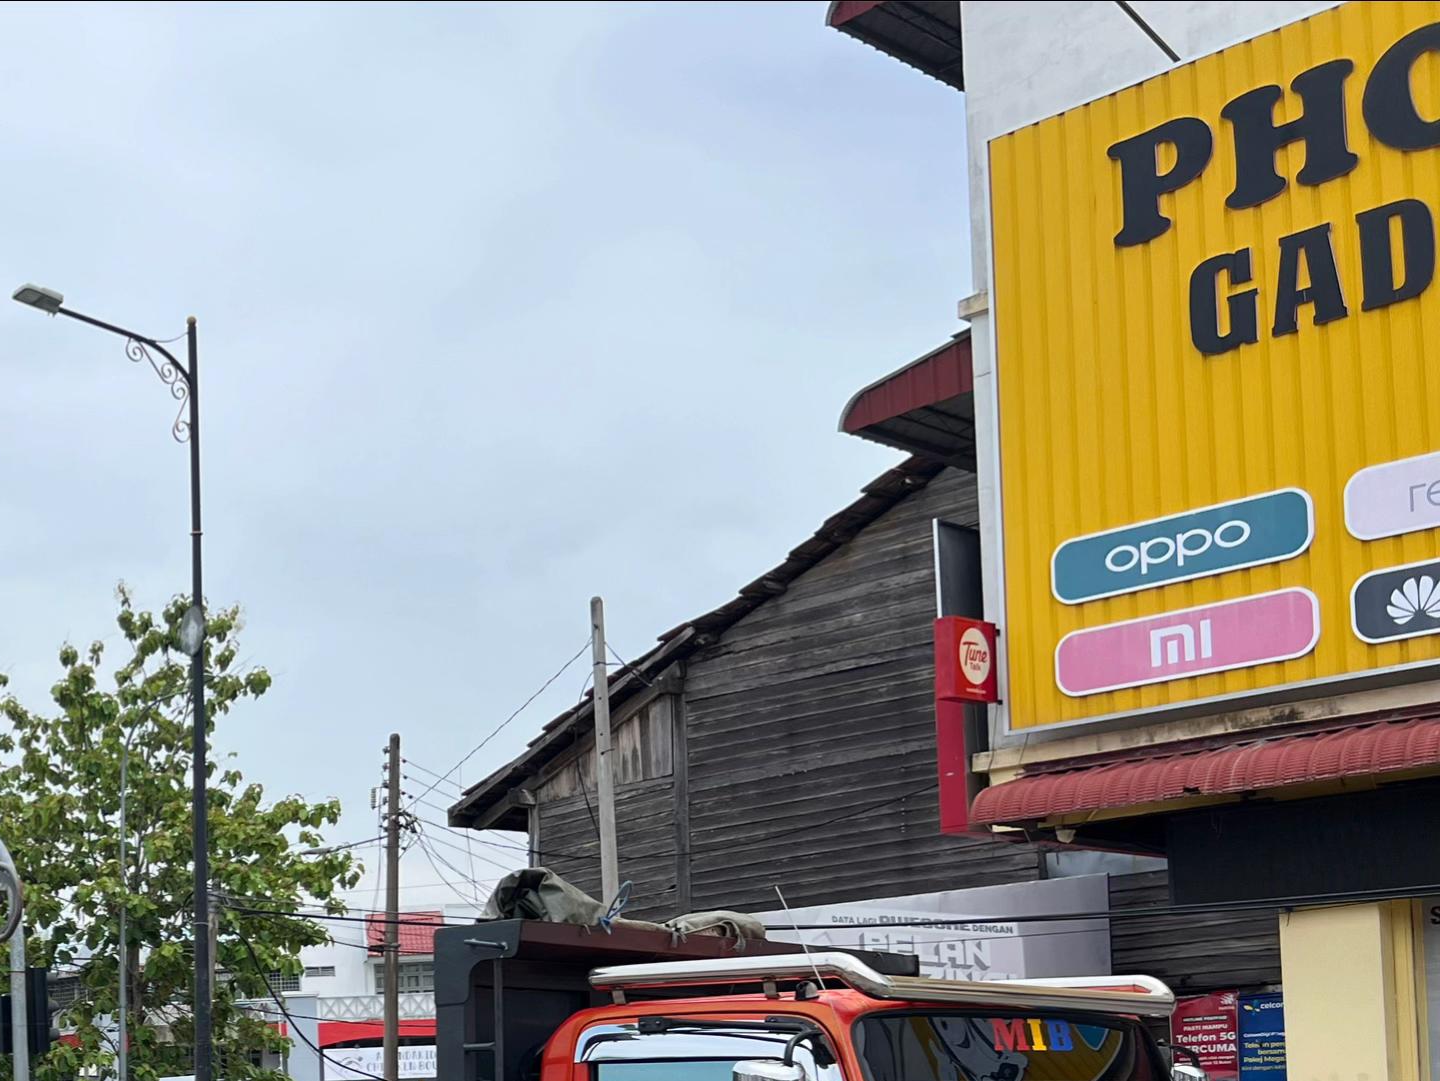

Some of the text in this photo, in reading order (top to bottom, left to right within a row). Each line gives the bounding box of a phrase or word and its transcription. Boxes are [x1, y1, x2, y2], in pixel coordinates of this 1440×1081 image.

[1107, 21, 1440, 247] PHO
[1188, 198, 1435, 356] GAD
[1105, 520, 1251, 575] oppo
[963, 642, 987, 666] Tune
[832, 915, 855, 925] DATA
[972, 924, 1014, 934] DENGAN
[991, 1018, 1073, 1051] MIB
[1176, 1034, 1216, 1043] Telefon
[1220, 1032, 1236, 1040] 5G
[1177, 1043, 1236, 1055] RCUMA
